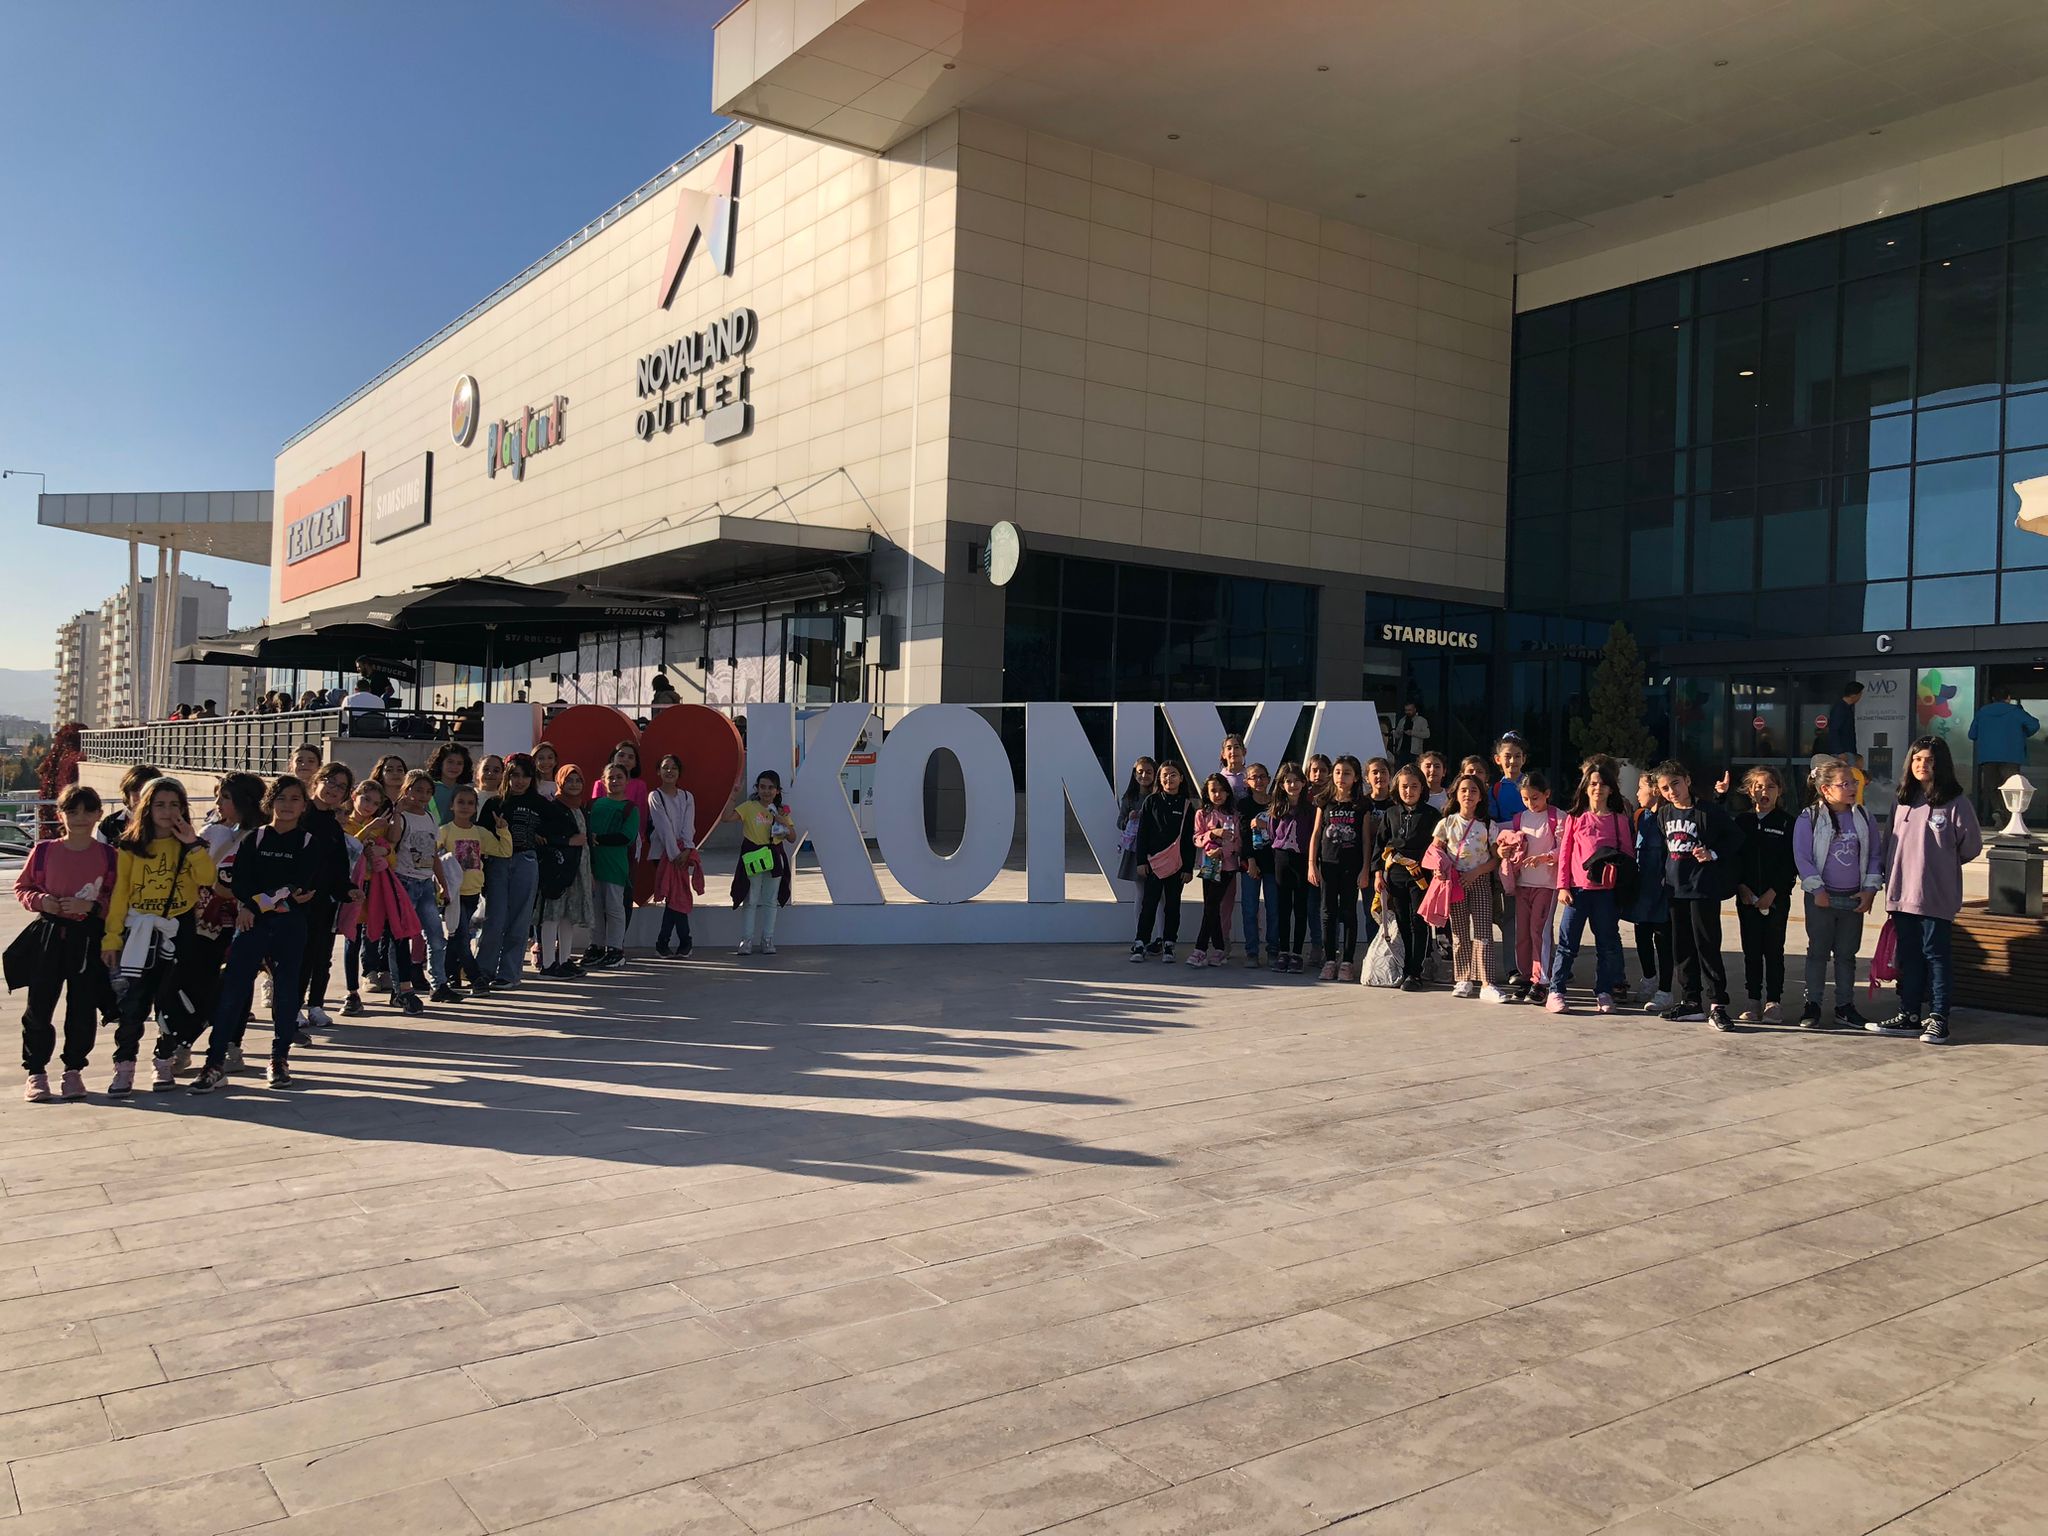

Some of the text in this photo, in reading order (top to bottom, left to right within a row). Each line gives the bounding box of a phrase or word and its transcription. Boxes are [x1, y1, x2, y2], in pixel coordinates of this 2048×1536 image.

[636, 306, 757, 398] NOVALAND
[635, 365, 753, 441] OUTLET
[376, 477, 420, 521] SAMSUNG
[286, 499, 347, 561] TEKZEN
[604, 606, 666, 618] STARBUCKS
[1382, 623, 1478, 649] STARBUCKS
[1875, 634, 1894, 653] C
[1867, 679, 1898, 694] MAD
[747, 701, 1388, 904] KONYA
[131, 900, 188, 911] CATICRN
